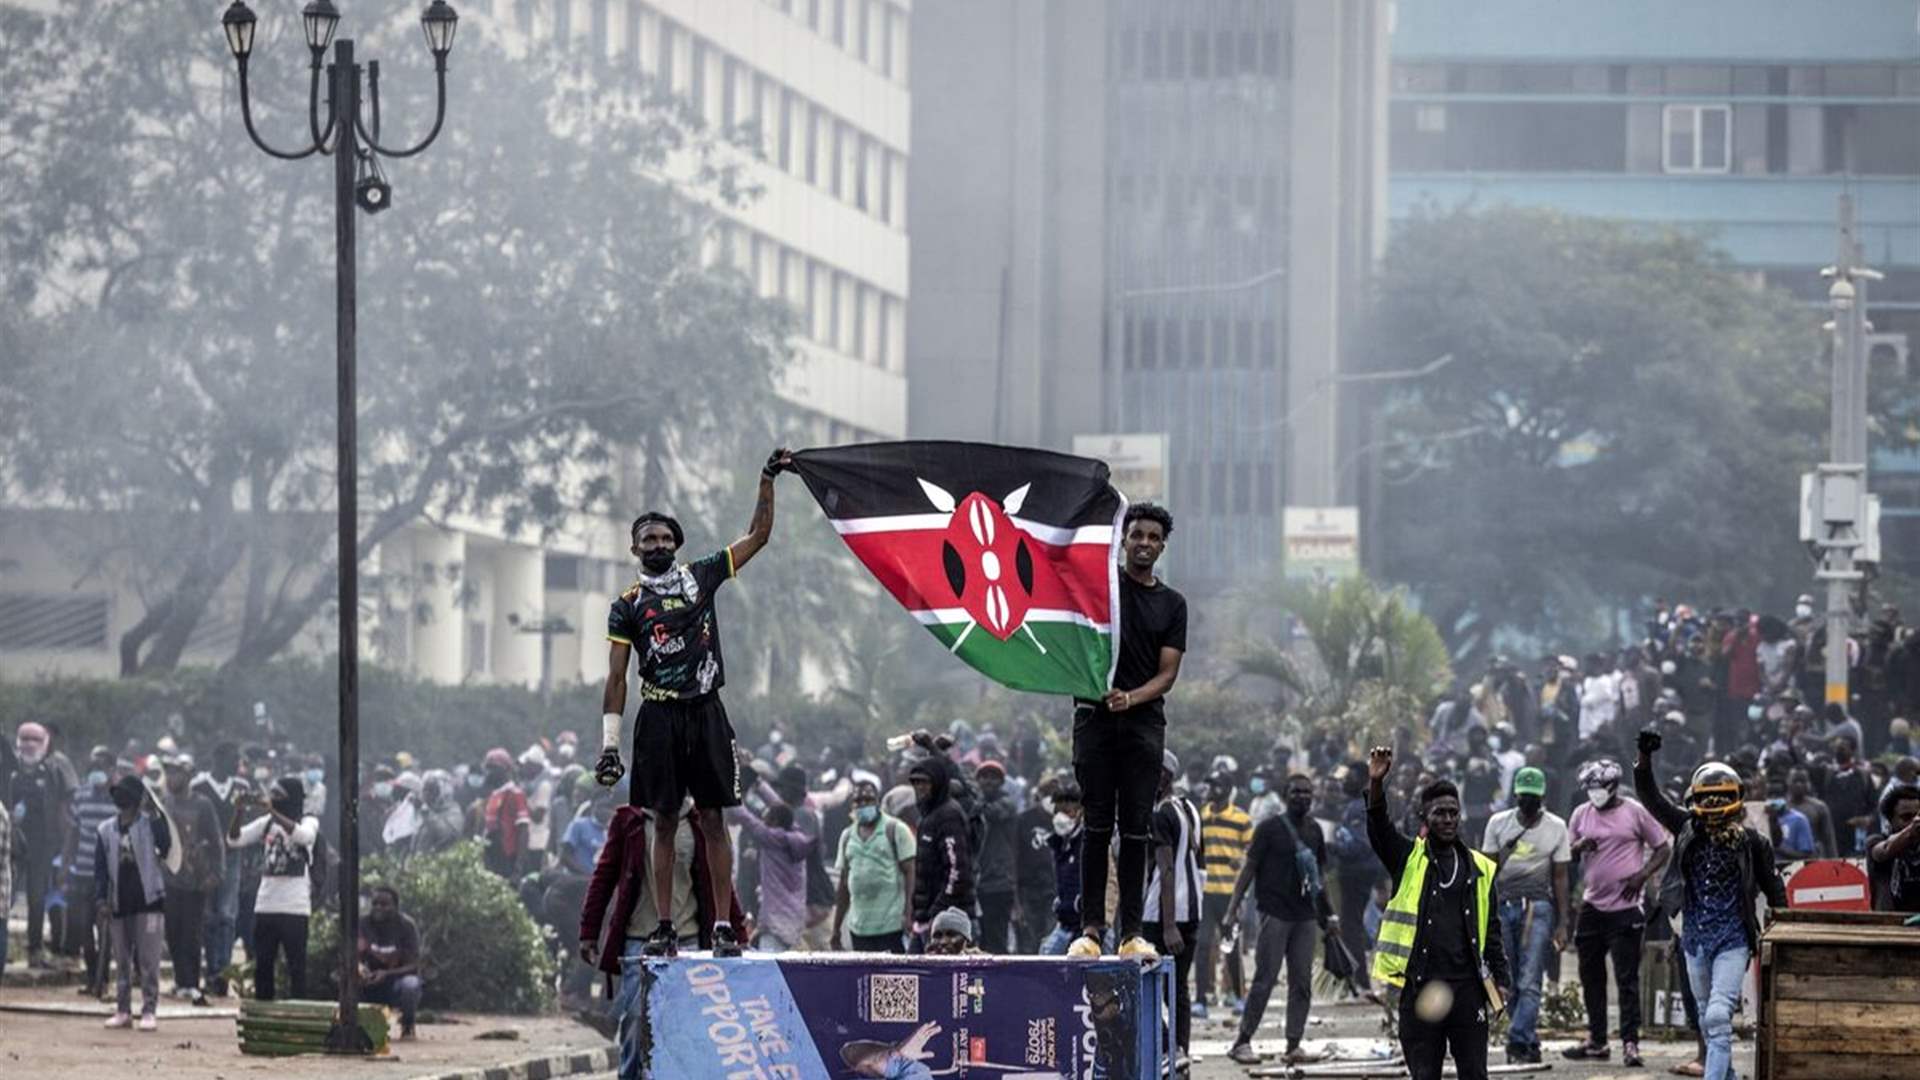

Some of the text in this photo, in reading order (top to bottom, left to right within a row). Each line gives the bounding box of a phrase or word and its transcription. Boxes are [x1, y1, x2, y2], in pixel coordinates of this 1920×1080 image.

[959, 972, 968, 993] PAY
[740, 995, 790, 1057] TAKE
[959, 1027, 968, 1048] PAY
[1028, 1018, 1040, 1065] 79079
[1047, 1017, 1055, 1068] PLAY NOW
